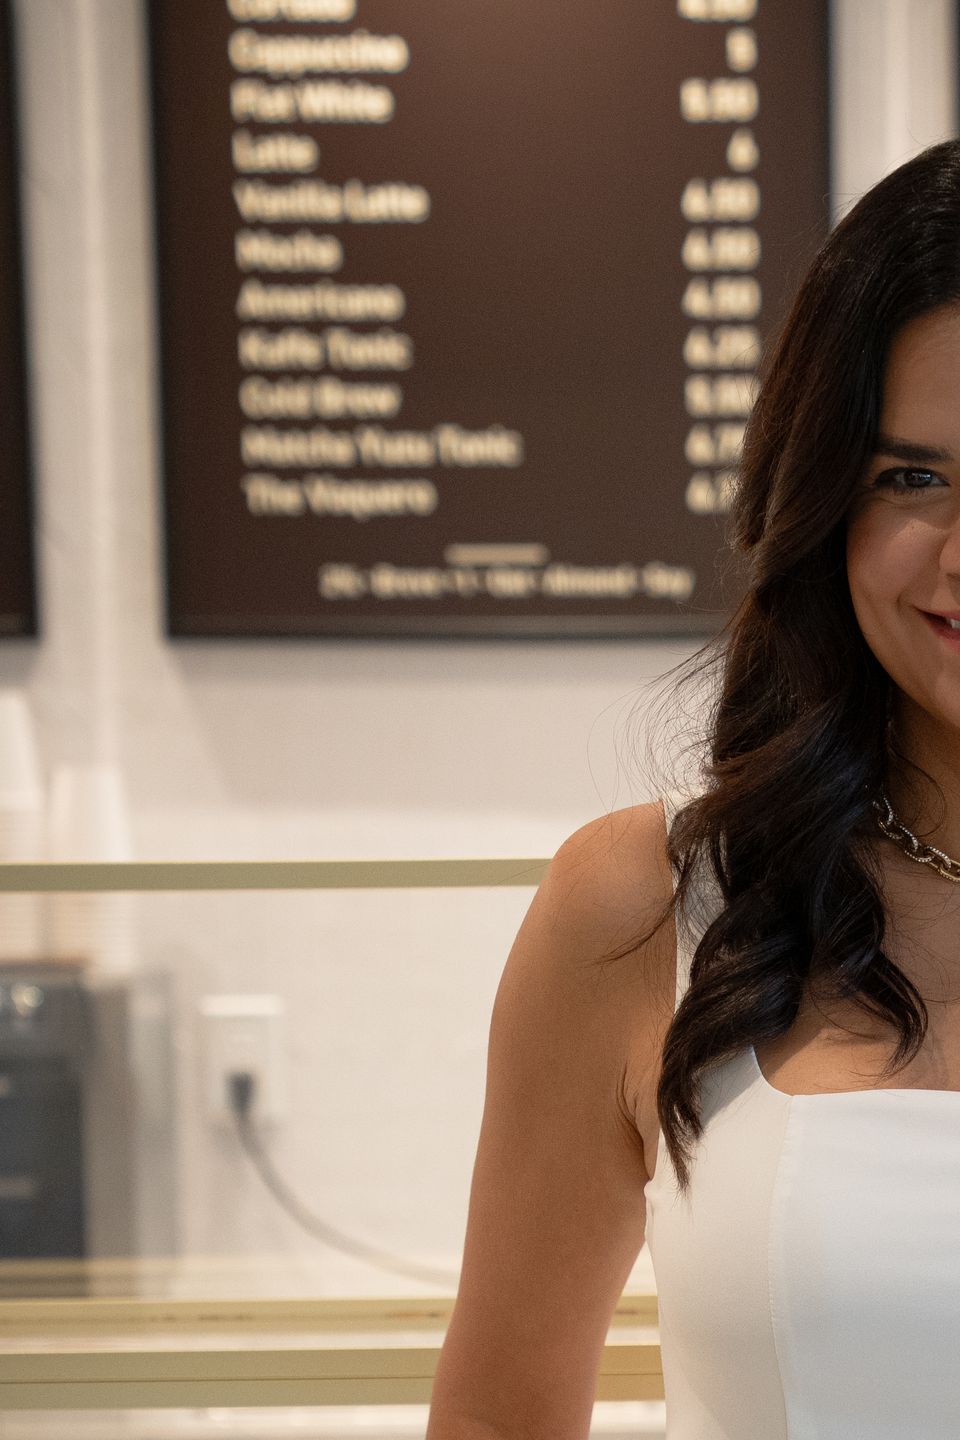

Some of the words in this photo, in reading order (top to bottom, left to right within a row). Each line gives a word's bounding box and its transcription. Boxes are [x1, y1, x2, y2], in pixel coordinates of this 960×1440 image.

[229, 30, 408, 76] Cappuccino
[296, 81, 394, 121] White
[232, 131, 319, 171] Latte
[234, 180, 346, 221] Vanilla
[346, 180, 430, 221] Latte
[236, 230, 343, 271] Mocha
[236, 279, 405, 320] Americano
[323, 329, 414, 369] Tonic
[240, 378, 315, 418] Cold
[315, 378, 402, 418] Brew
[240, 427, 355, 467] Matcha
[434, 427, 525, 466] Tonic
